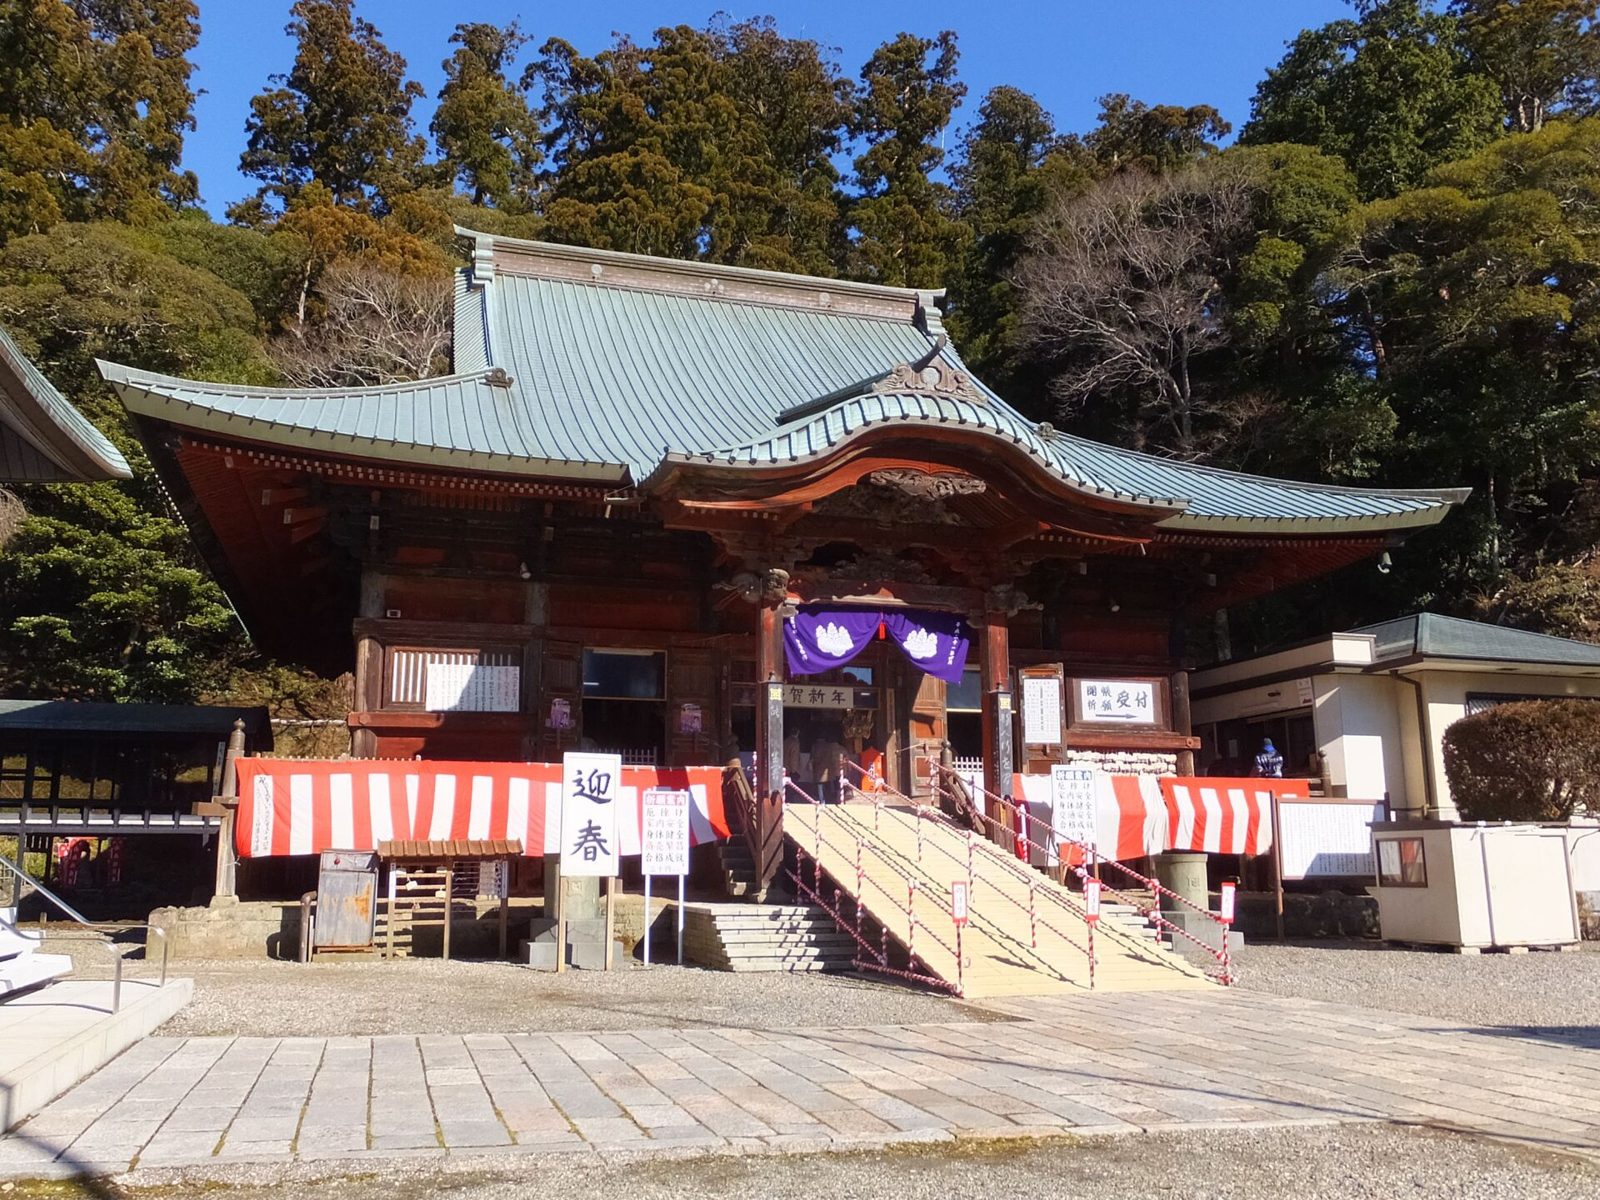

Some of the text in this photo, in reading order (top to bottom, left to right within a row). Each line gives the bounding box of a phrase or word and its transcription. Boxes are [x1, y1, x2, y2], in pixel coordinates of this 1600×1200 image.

[783, 687, 845, 705] 賀新年
[1117, 689, 1147, 708] 受付
[570, 768, 612, 862] 迎春
